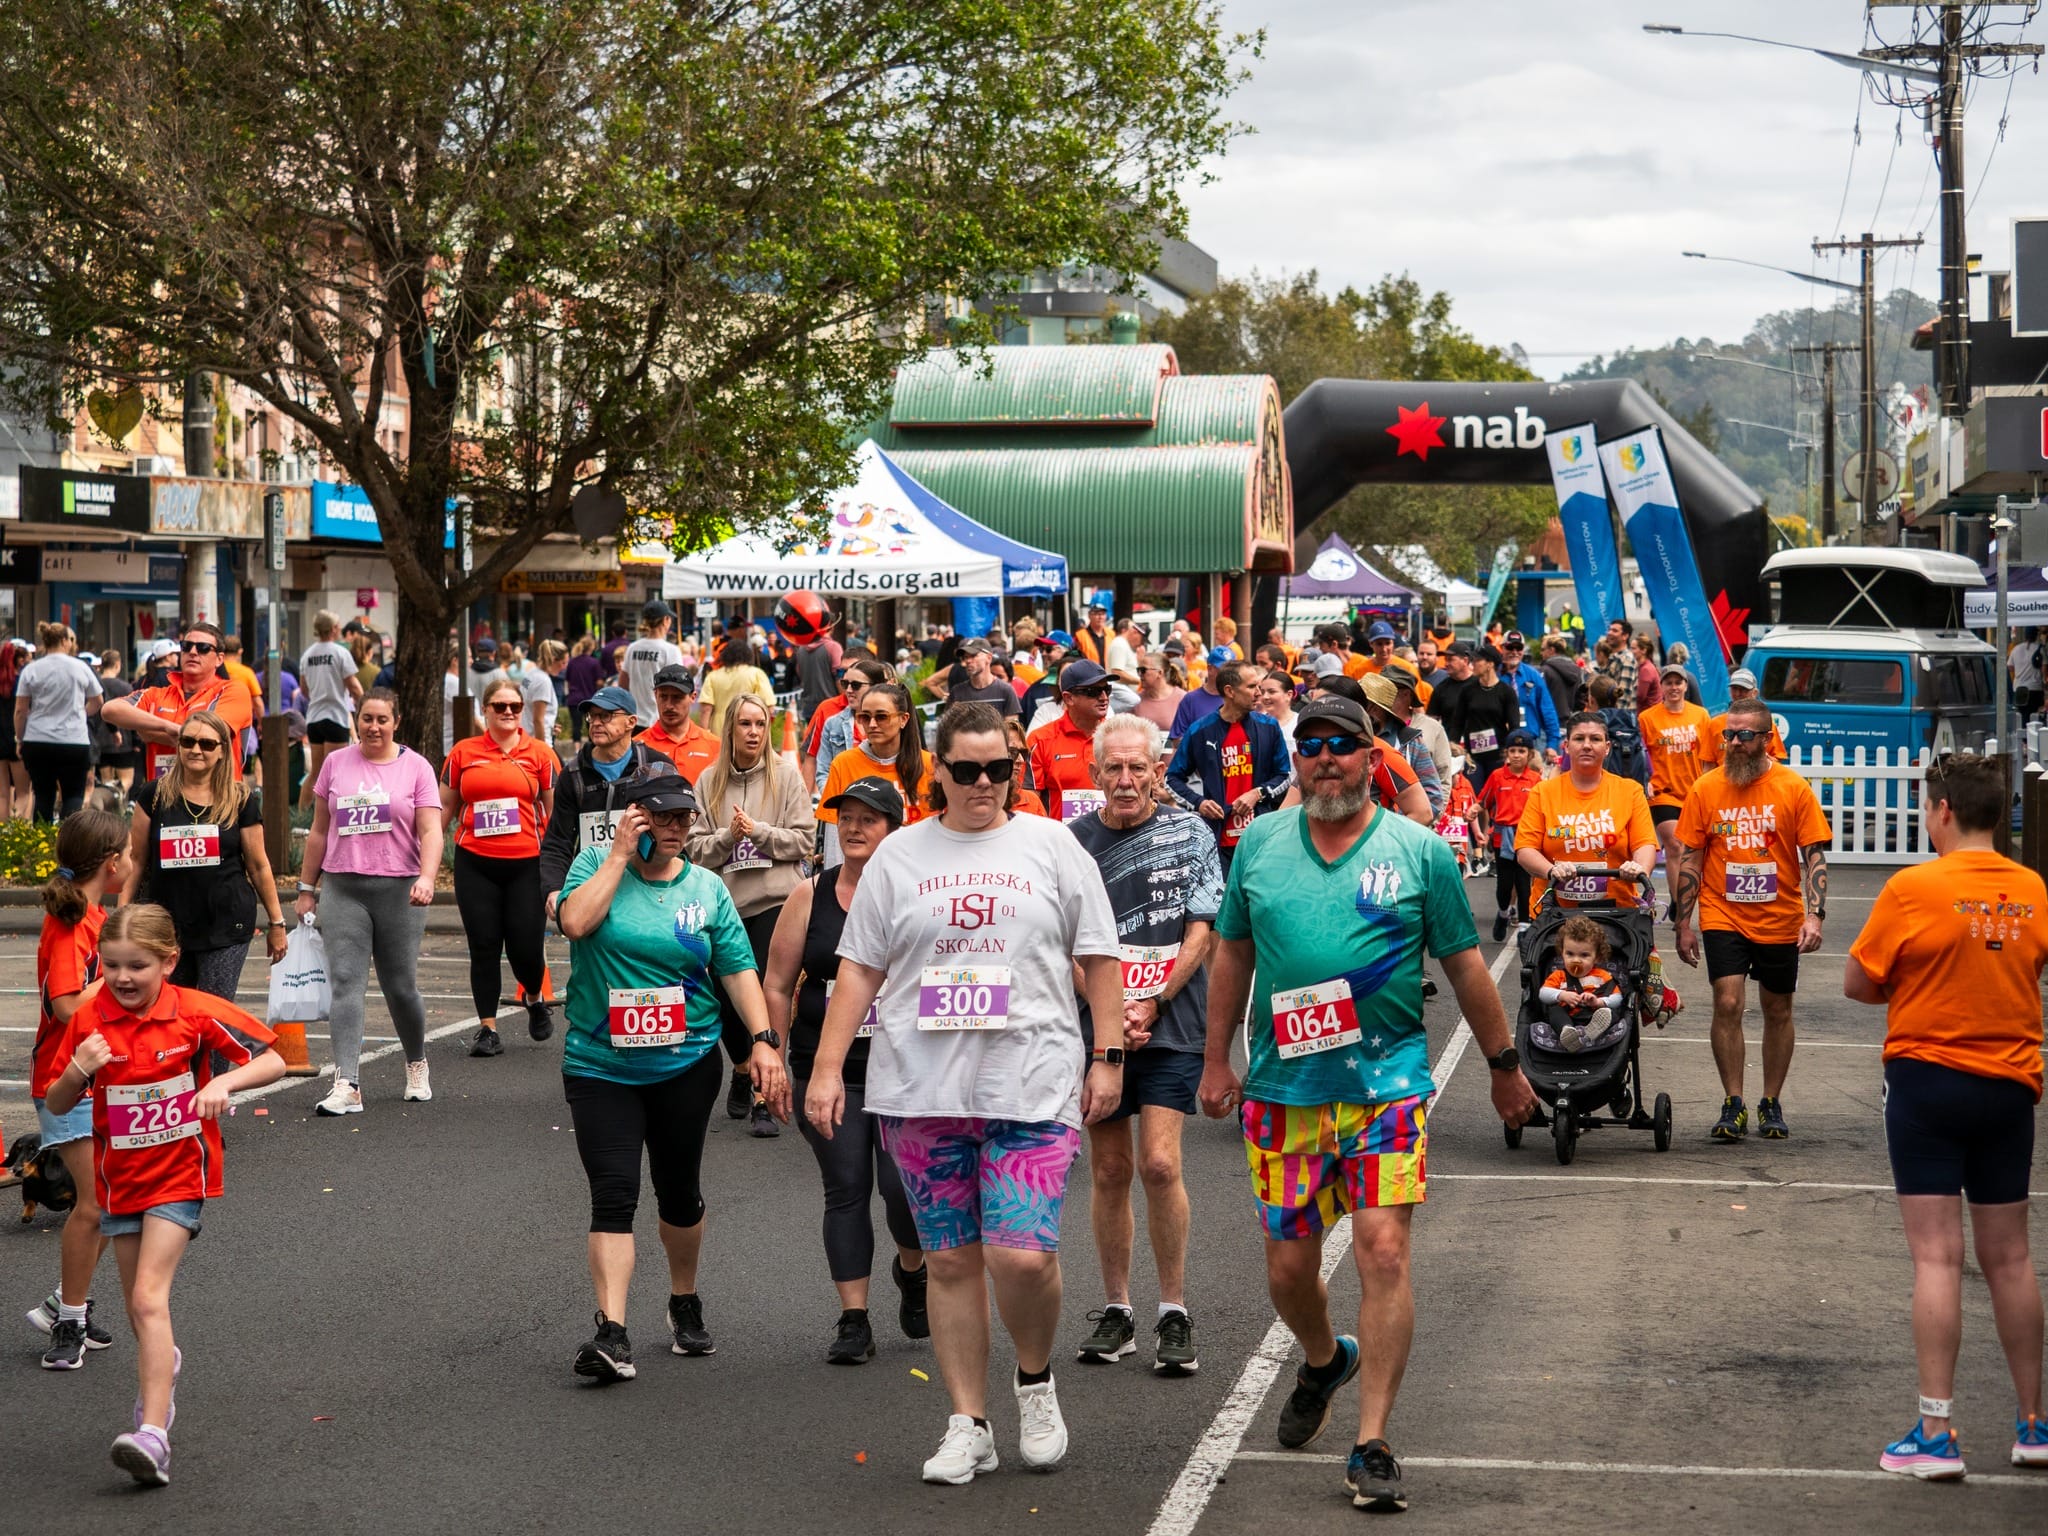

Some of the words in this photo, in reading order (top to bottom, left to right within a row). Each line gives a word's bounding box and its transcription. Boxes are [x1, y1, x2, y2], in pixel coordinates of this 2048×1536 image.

[1453, 407, 1546, 449] nab
[91, 483, 116, 504] BLOCK
[45, 557, 73, 571] CAFE
[1654, 534, 1680, 593] Tomorrow
[705, 568, 960, 594] www.ourkids.org.au
[1364, 595, 1401, 607] College
[1964, 603, 1992, 615] tudy
[308, 654, 334, 667] NURSE
[632, 650, 659, 662] NURSE
[1660, 724, 1697, 738] WALK
[1674, 731, 1697, 744] RUN
[1221, 746, 1238, 758] UN
[1667, 741, 1697, 755] FUND
[1222, 755, 1247, 768] UND
[1223, 766, 1241, 777] UR
[348, 806, 380, 826] 272
[482, 811, 510, 828] 175
[1557, 808, 1613, 826] WALK
[1718, 804, 1776, 821] WALK
[590, 823, 617, 842] 130
[1442, 825, 1463, 836] 223
[1575, 820, 1616, 839] RUN
[1737, 818, 1776, 835] RUN
[173, 838, 207, 858] 108
[1564, 833, 1618, 854] FUND
[1726, 832, 1777, 852] FUND
[732, 845, 759, 862] 162
[917, 872, 1033, 896] HILLERSKA
[1563, 876, 1597, 893] 246
[1735, 876, 1768, 894] 242
[931, 905, 945, 918] 19
[1001, 905, 1017, 918] 01
[935, 938, 1006, 955] SKOLAN
[1127, 962, 1168, 988] 095
[934, 986, 993, 1016] 300
[623, 1007, 674, 1034] 065
[934, 1018, 961, 1027] OUR
[962, 1017, 990, 1027] KIDS
[1286, 1004, 1343, 1043] 064
[624, 1036, 647, 1045] OUR
[649, 1034, 673, 1045] KIDS
[1291, 1041, 1315, 1055] OUR
[1316, 1034, 1345, 1050] KIDS
[111, 1054, 129, 1063] NECT
[165, 1043, 191, 1057] CONNECT
[127, 1097, 182, 1135] 226
[129, 1132, 156, 1147] OUR
[158, 1126, 186, 1143] KIDS
